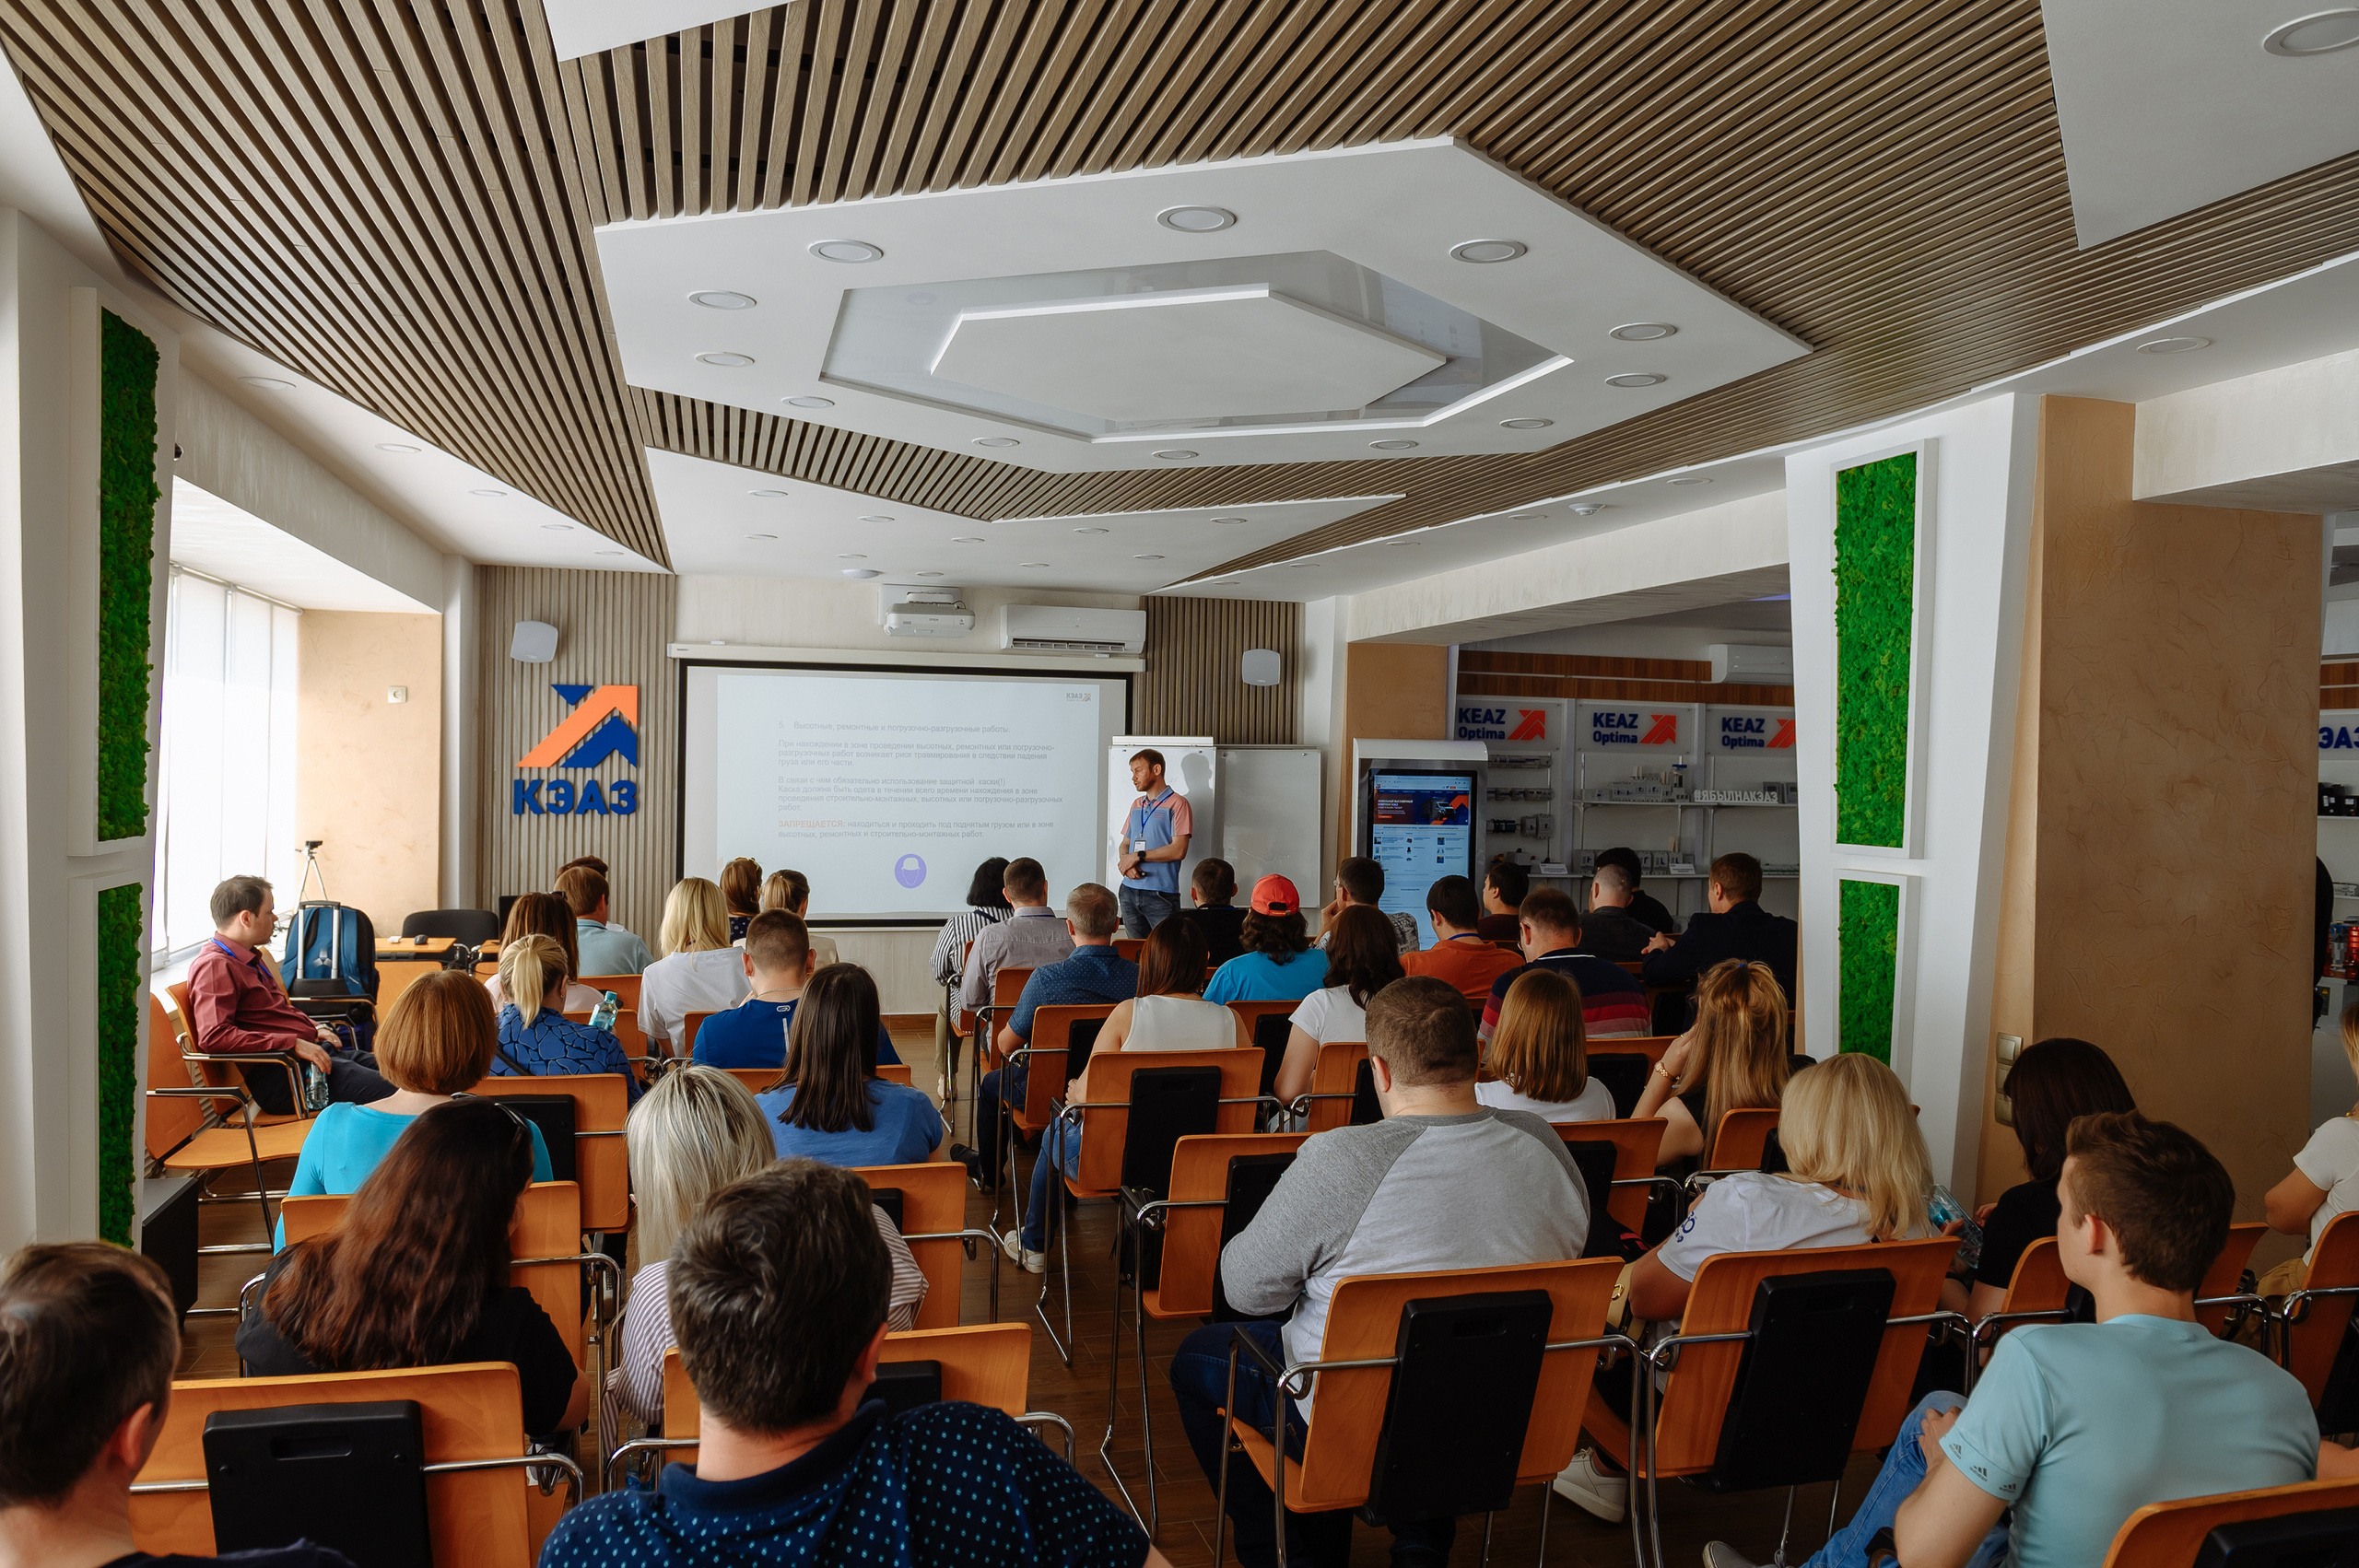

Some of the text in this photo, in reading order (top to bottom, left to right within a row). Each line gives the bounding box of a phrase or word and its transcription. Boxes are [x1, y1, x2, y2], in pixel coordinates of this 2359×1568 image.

[1459, 708, 1506, 725] KEAZ
[1593, 713, 1638, 729] KEAZ
[794, 721, 835, 731] Высотные,
[888, 724, 980, 733] погрузочно-разгрузочные
[982, 725, 1010, 733] работы.
[1722, 717, 1765, 733] KEAZ
[1459, 726, 1506, 740] Optima
[1593, 731, 1638, 745] Optima
[779, 740, 794, 748] При
[797, 741, 842, 749] нахождении
[1722, 735, 1765, 749] Optima
[833, 777, 880, 785] обязательно
[513, 779, 638, 815] КЭАЗ
[1694, 790, 1778, 803] #ЯБЫЛНАКЭАЗ
[779, 820, 846, 829] ЗАПРЕЩАЕТСЯ:
[820, 831, 862, 839] ремонтных
[962, 830, 984, 838] работ.
[1970, 1467, 1988, 1482] adidas
